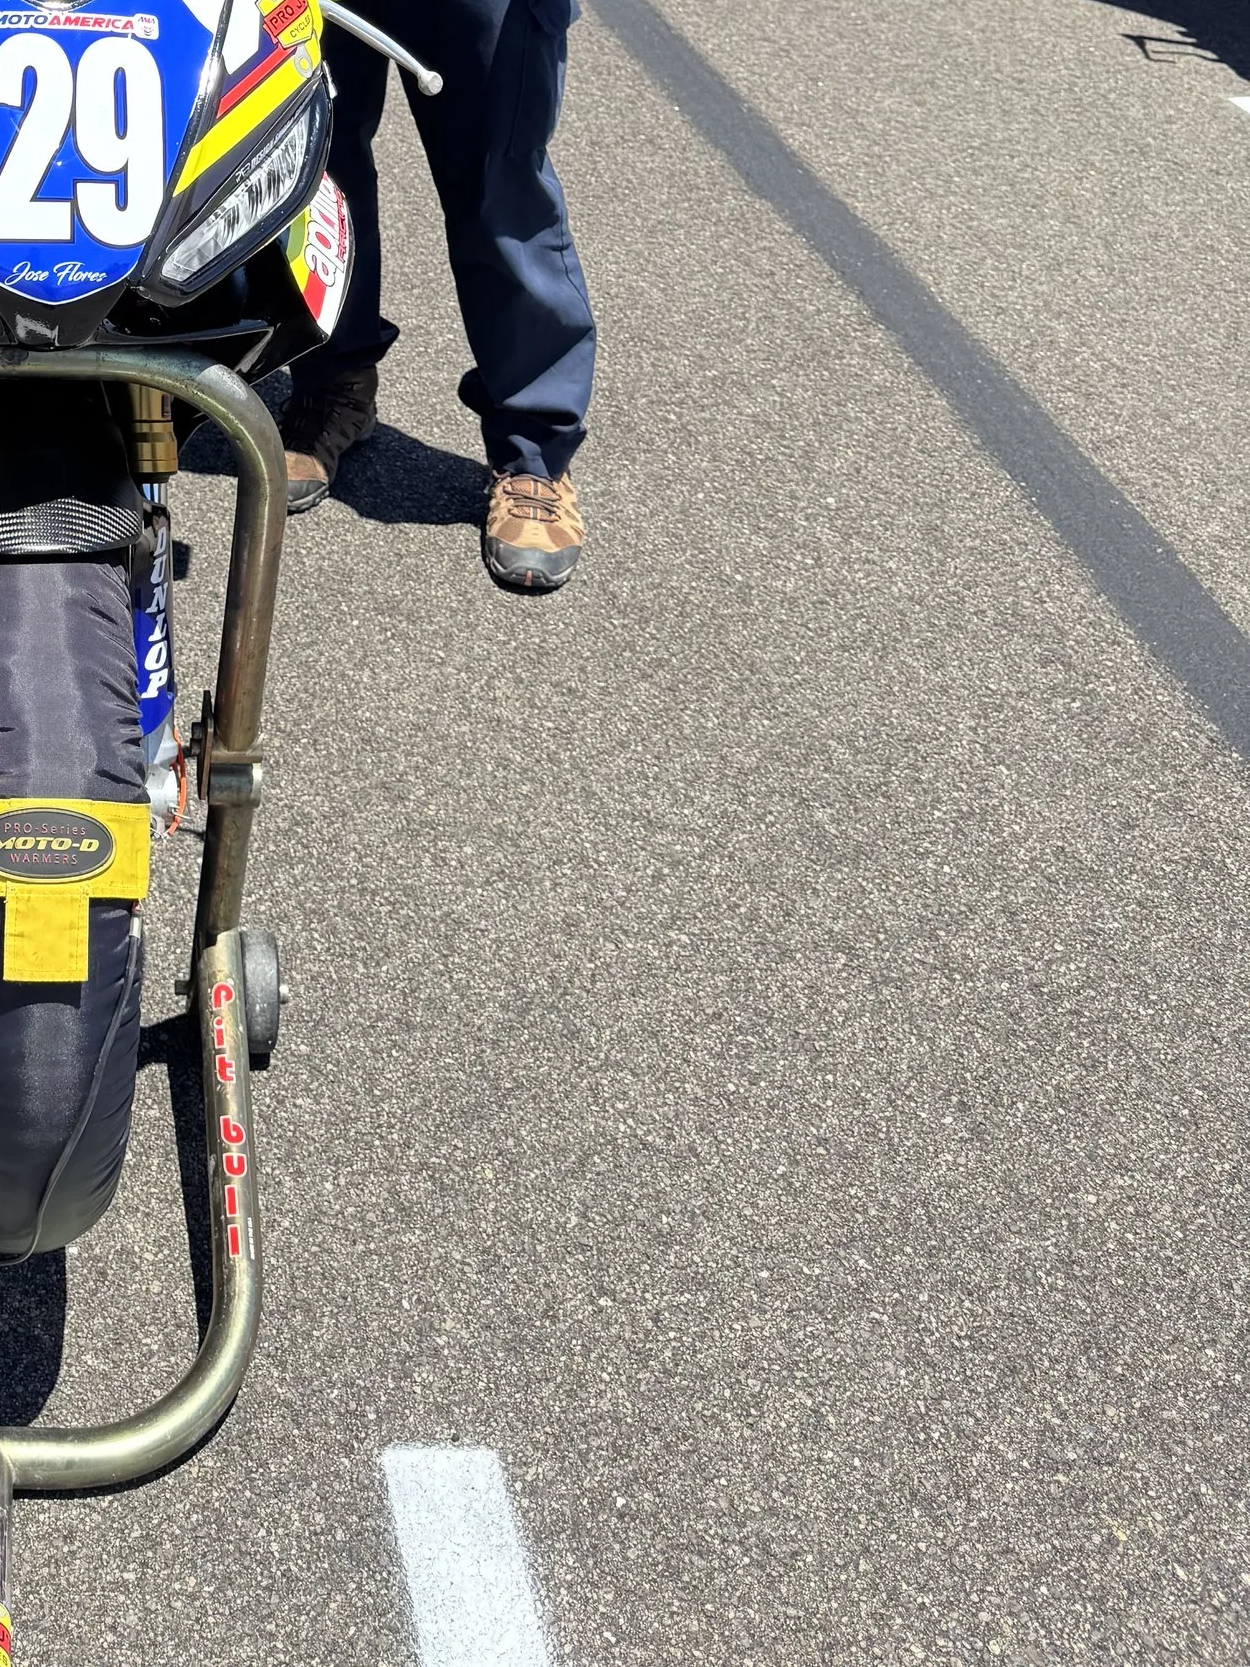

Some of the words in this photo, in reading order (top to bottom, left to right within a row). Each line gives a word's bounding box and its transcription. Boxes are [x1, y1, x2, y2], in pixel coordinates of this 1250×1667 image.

[269, 3, 295, 30] PRO
[4, 260, 51, 287] Jose
[52, 260, 109, 287] Flores
[140, 525, 170, 699] DUNLOP
[3, 822, 87, 836] PRO-Series
[9, 853, 79, 865] WARMERS
[210, 980, 237, 1086] pit
[219, 1114, 249, 1259] bull
